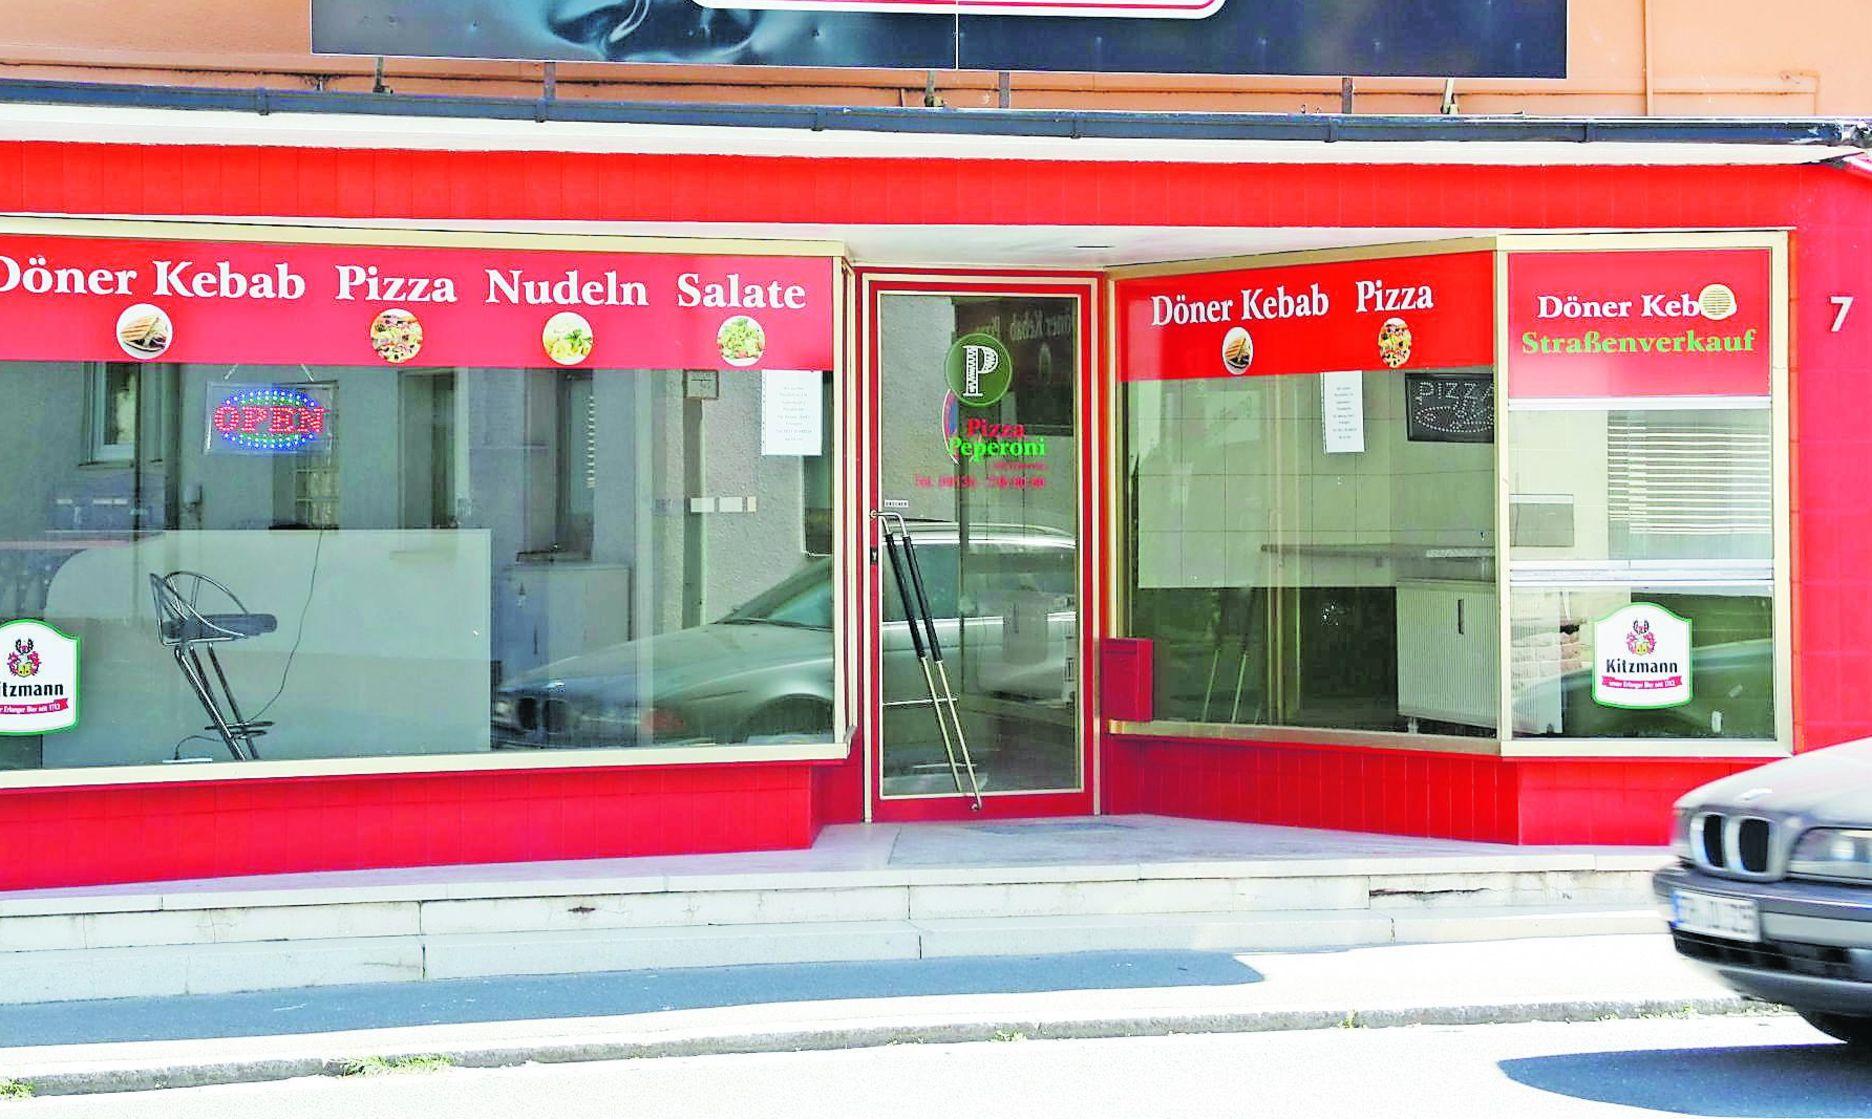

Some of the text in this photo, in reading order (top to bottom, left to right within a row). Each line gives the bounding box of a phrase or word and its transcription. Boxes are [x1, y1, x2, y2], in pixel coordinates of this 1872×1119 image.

[0, 256, 807, 310] Döner Kebab Pizza Nudeln Salate
[1151, 279, 1434, 326] Döner Kebab Pizza
[1537, 293, 1701, 319] Döner Keb
[1830, 296, 1854, 332] 7
[1521, 328, 1758, 355] Straßenverkauf
[962, 344, 999, 398] P
[214, 405, 326, 434] OPEN
[967, 418, 1026, 438] Pizza
[947, 436, 1046, 463] Peperoni
[1606, 658, 1678, 673] Kitzmann
